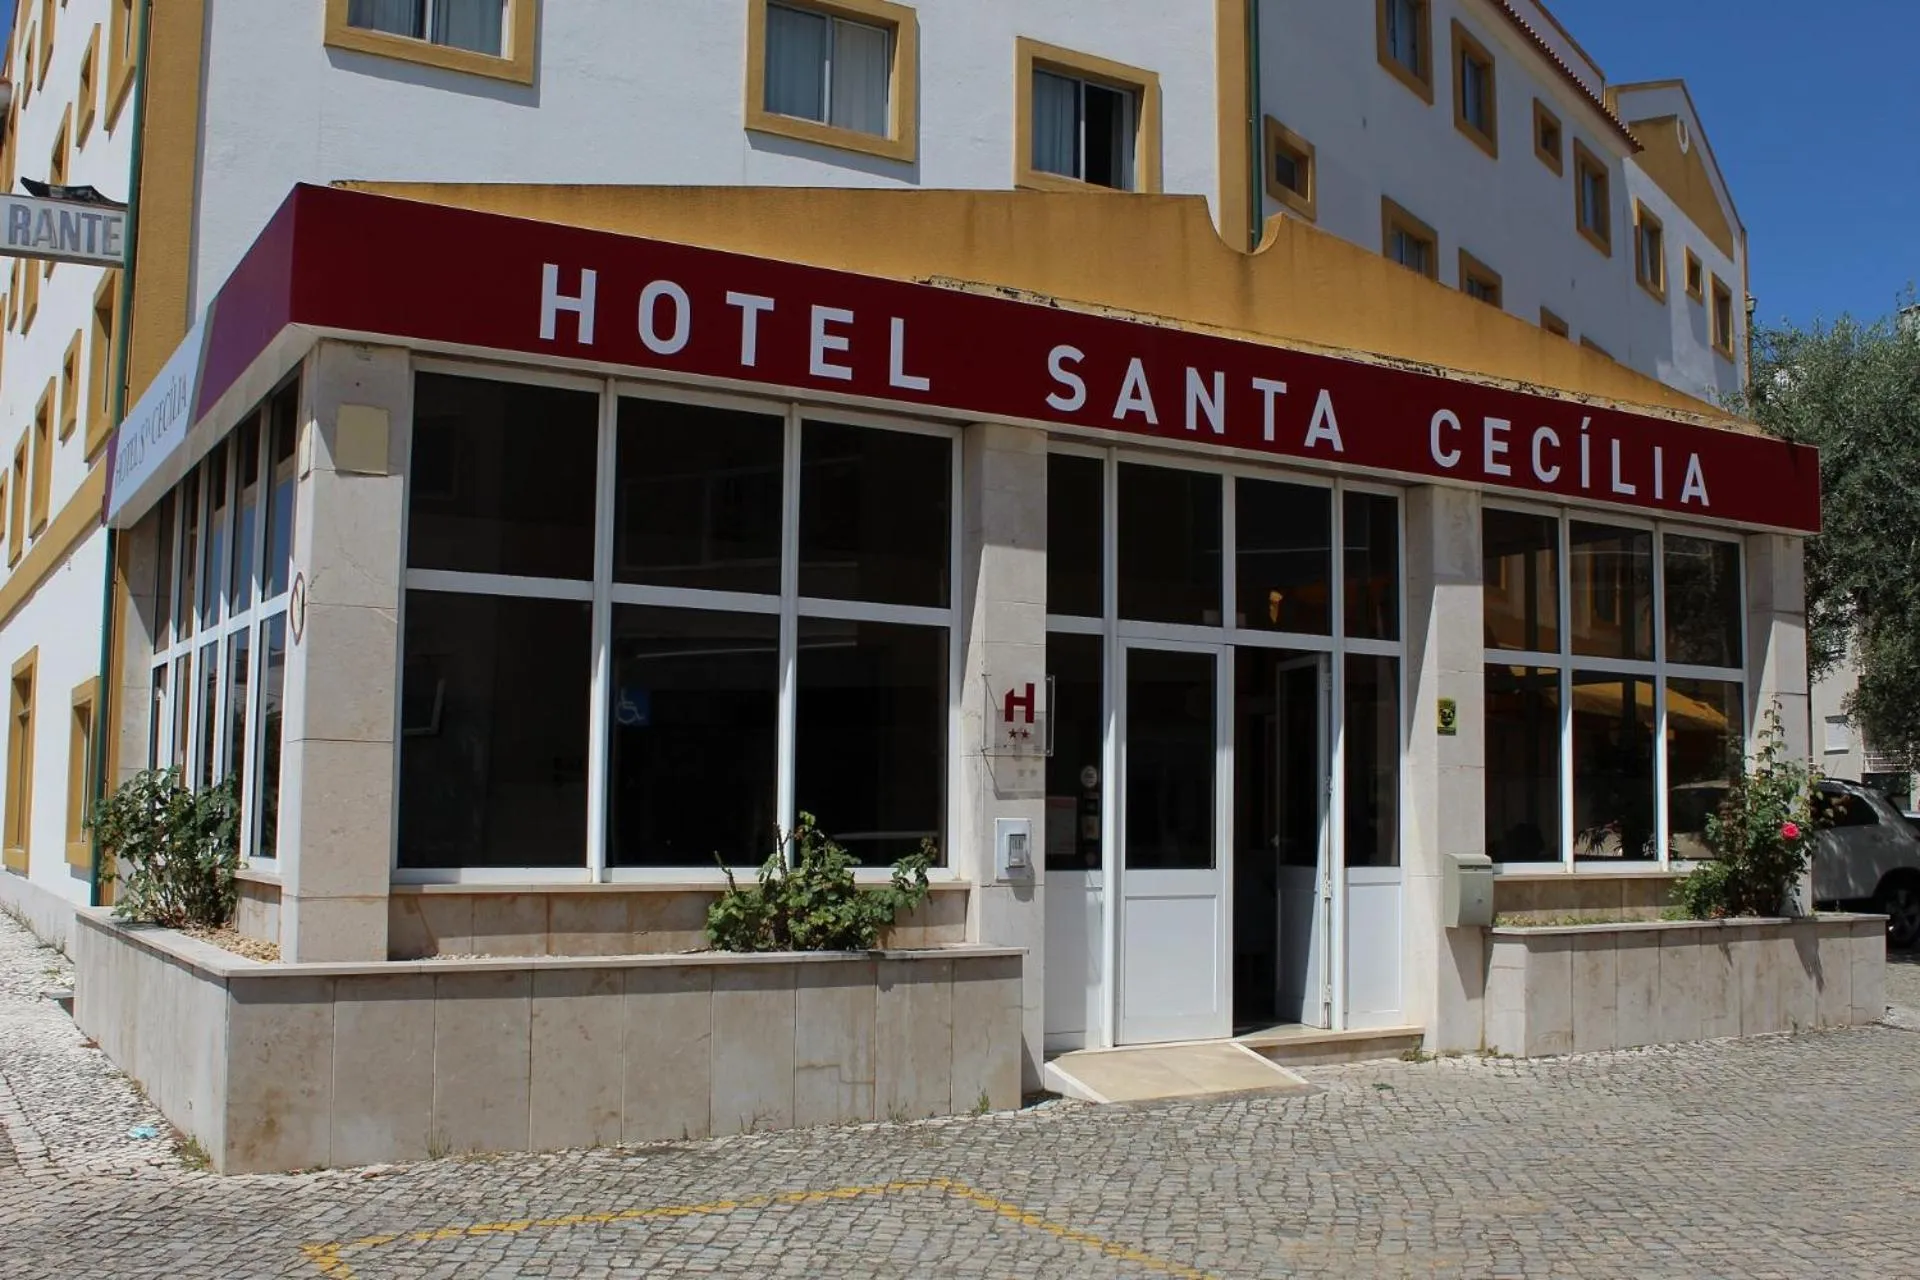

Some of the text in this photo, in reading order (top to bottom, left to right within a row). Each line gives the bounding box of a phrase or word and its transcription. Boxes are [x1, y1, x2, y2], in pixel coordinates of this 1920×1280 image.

[8, 203, 122, 256] RANTE
[538, 262, 1710, 507] HOTEL SANTA CECÍLIA
[1004, 682, 1035, 724] H
